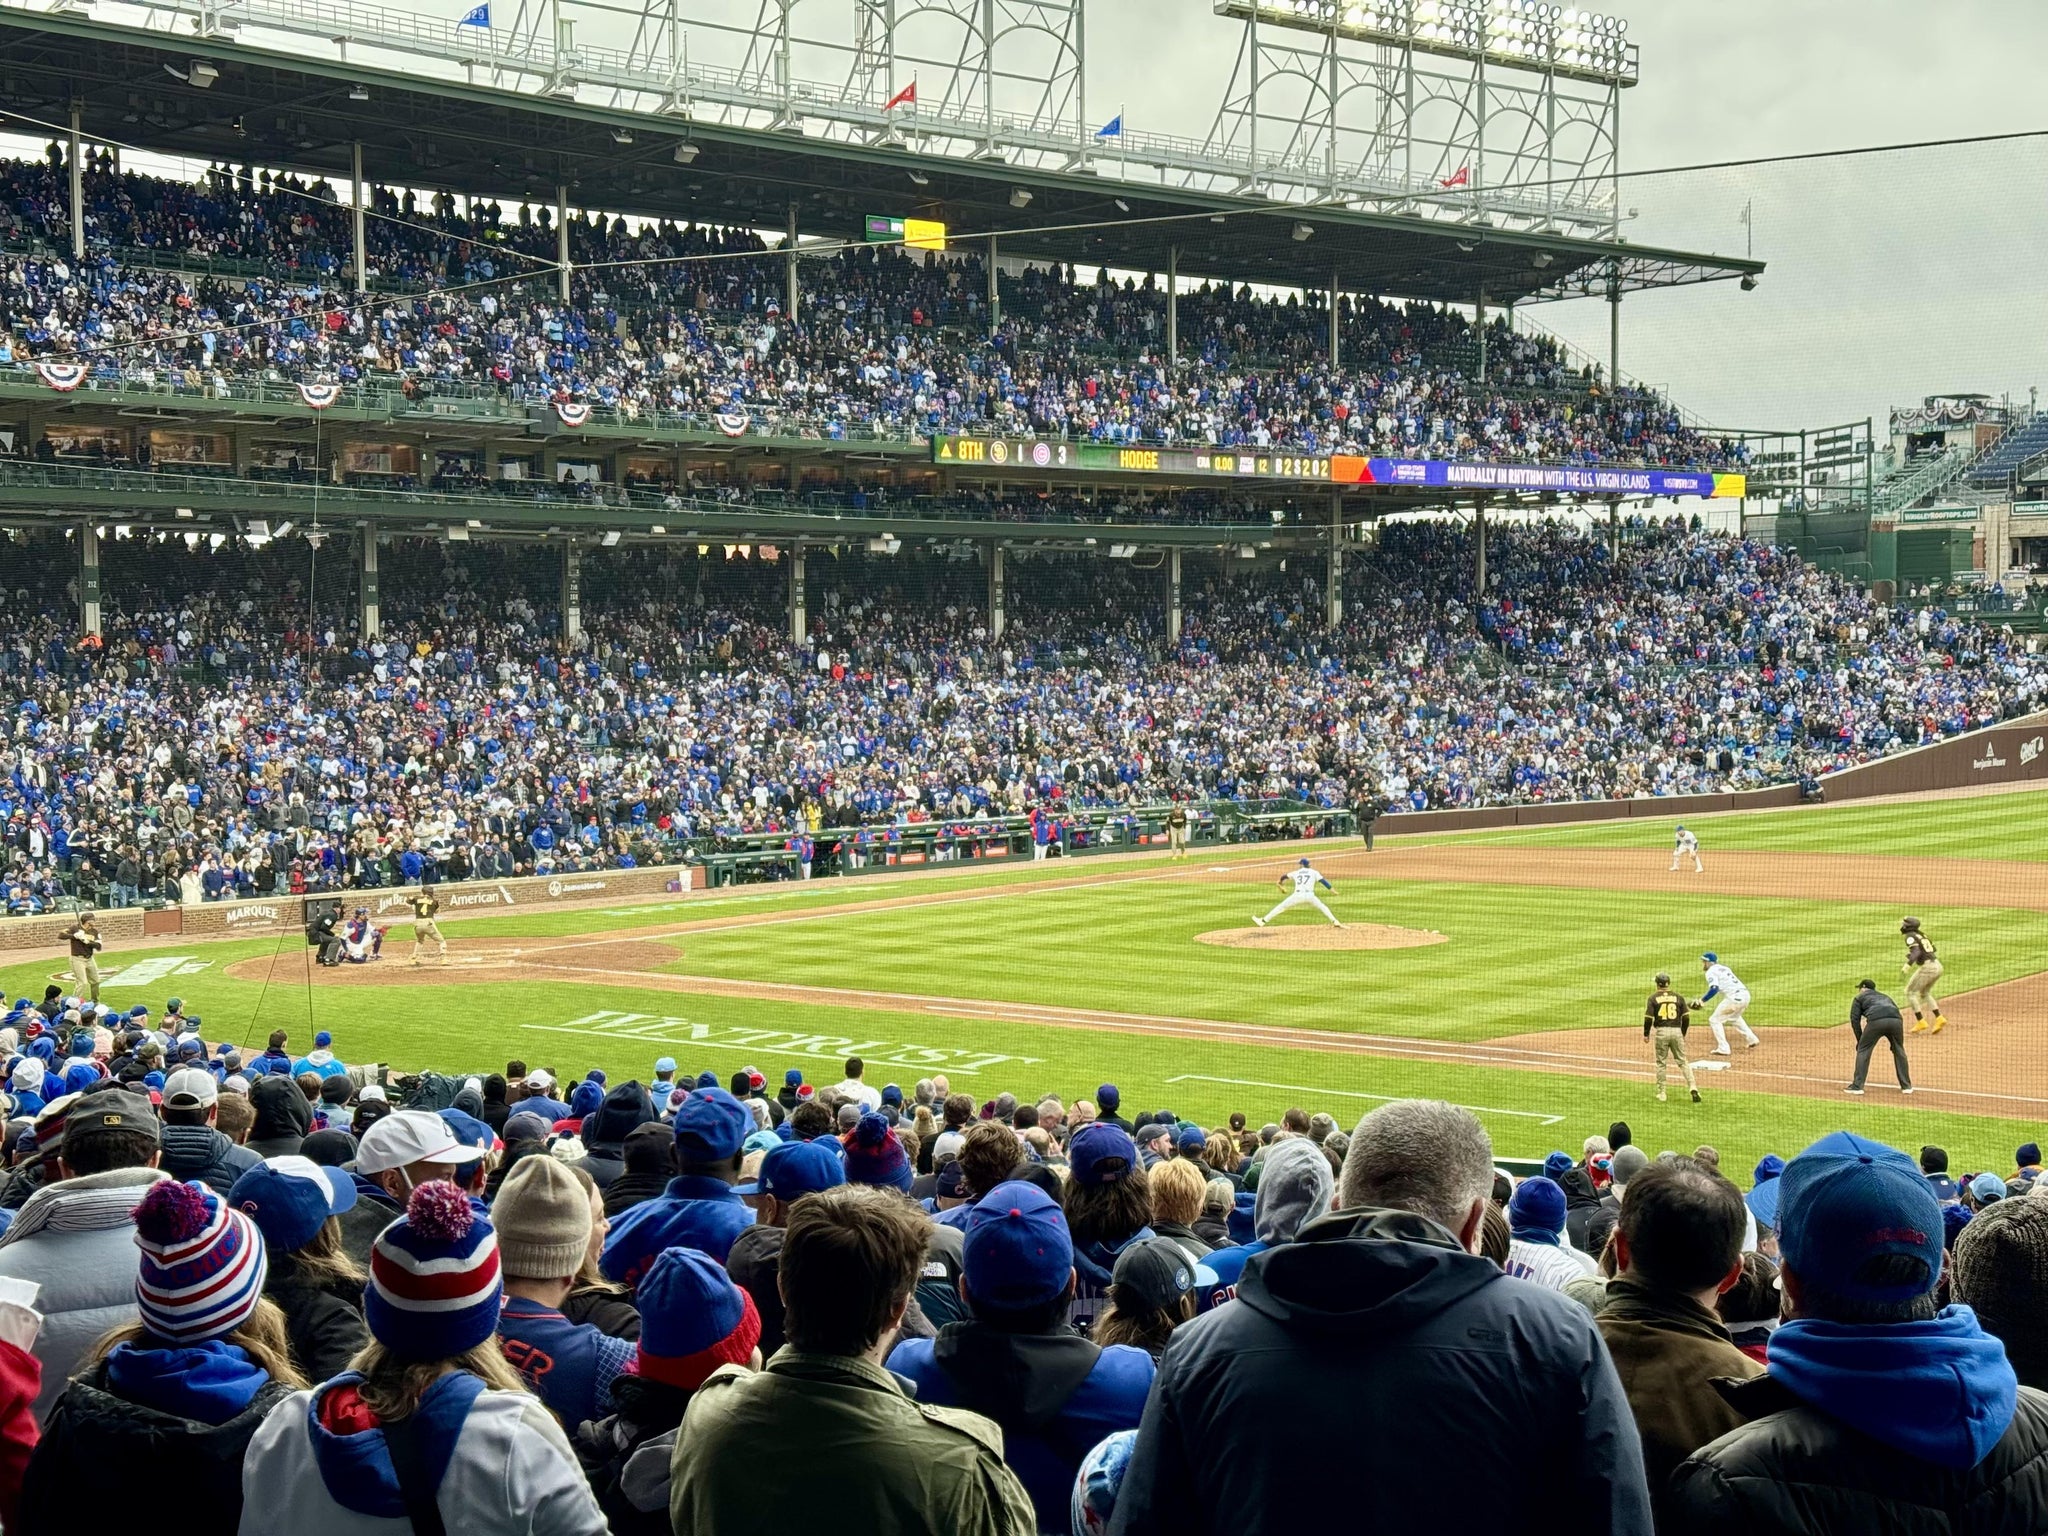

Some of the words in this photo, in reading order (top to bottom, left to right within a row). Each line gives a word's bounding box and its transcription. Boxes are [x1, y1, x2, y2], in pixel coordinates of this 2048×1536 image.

[959, 441, 983, 460] 8TH
[1018, 444, 1023, 462] 1
[1058, 446, 1067, 464] 3
[1120, 451, 1158, 469] HODGE
[1214, 457, 1233, 471] 0.00
[1259, 459, 1267, 472] 12
[1284, 458, 1292, 476] 2
[1294, 459, 1301, 476] S
[1302, 459, 1310, 477] 2
[1321, 460, 1328, 477] 2
[1447, 466, 1496, 483] NATURALLY
[1497, 468, 1507, 483] IN
[1508, 469, 1544, 485] RHYTHM
[1545, 470, 1565, 486] WITH
[1565, 471, 1580, 487] THE
[1581, 472, 1595, 487] U.S.
[1595, 474, 1620, 488] VIRGIN
[1621, 475, 1650, 489] ISLANDS
[1904, 510, 1977, 521] WRIGLEYROOFTOPS.COM
[562, 881, 606, 892] JamesHardie
[1296, 875, 1311, 885] 37
[450, 892, 499, 906] American
[226, 905, 279, 924] MARQUEE
[420, 904, 428, 916] 4
[1658, 1003, 1677, 1020] 46
[560, 1010, 1047, 1073] WINTRUST
